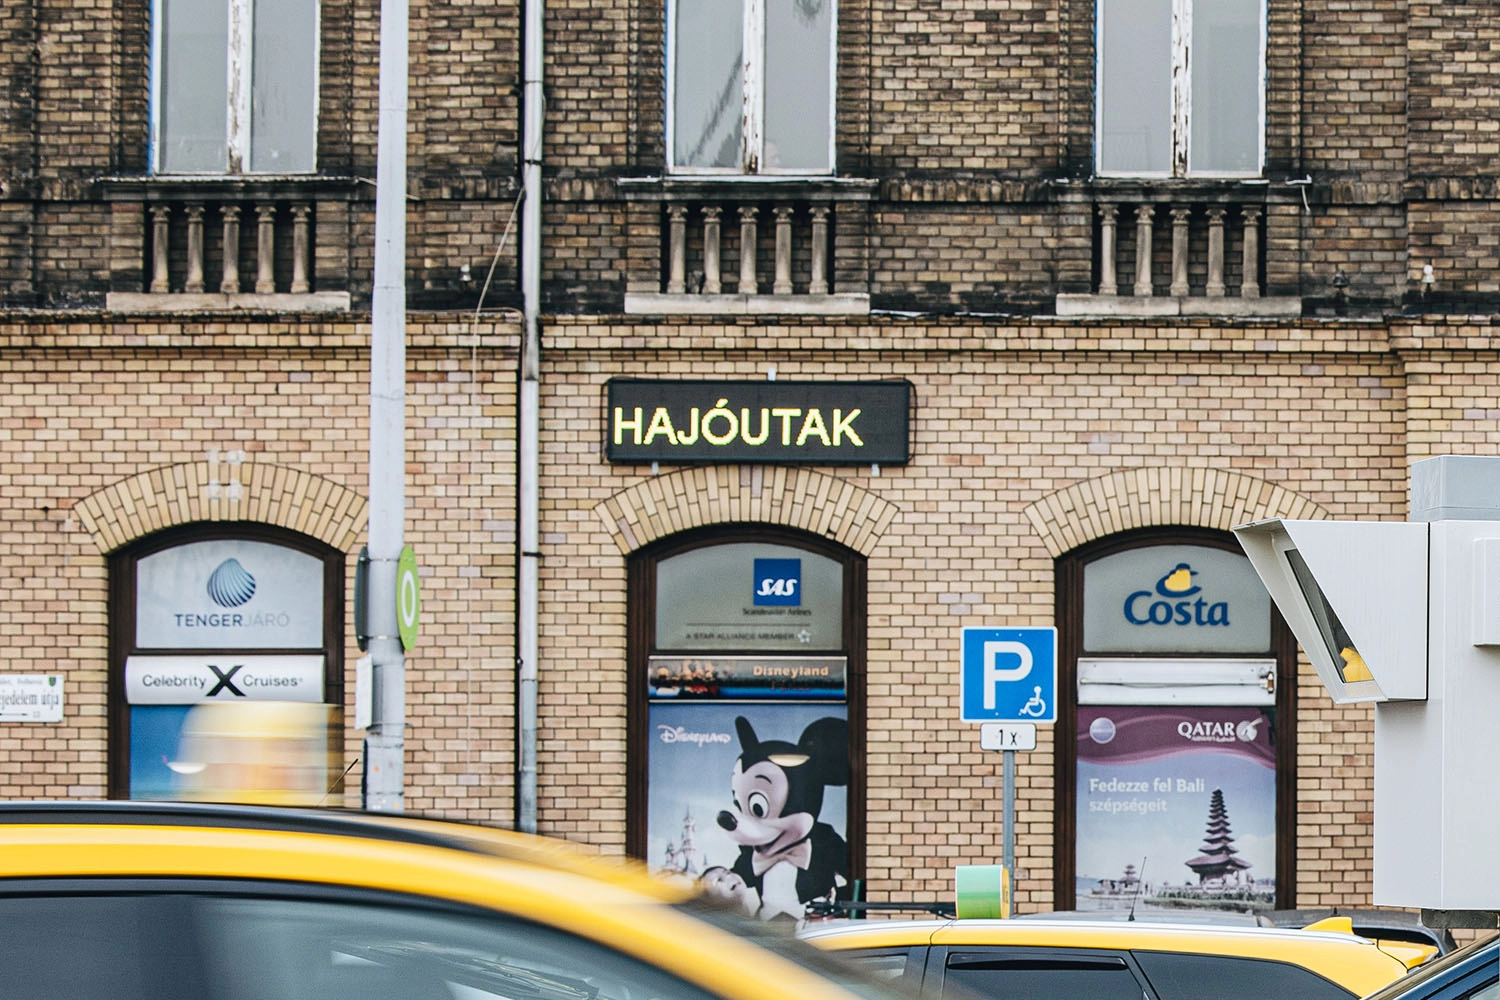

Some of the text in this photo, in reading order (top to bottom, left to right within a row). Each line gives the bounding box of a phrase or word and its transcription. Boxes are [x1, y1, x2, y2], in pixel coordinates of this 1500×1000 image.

[614, 398, 864, 446] HAJÓUTAK
[757, 578, 798, 597] SAS
[1124, 590, 1230, 626] Costa
[174, 611, 290, 628] TENGERJÁRÓ
[142, 674, 207, 689] Celebrity
[205, 665, 247, 697] X
[753, 665, 829, 679] Disneyland
[983, 640, 1033, 710] P
[998, 729, 1004, 746] 1
[1177, 722, 1235, 740] QATAR
[1089, 778, 1205, 793] Fedezze fel Bali
[1089, 798, 1168, 815] szépségeit
